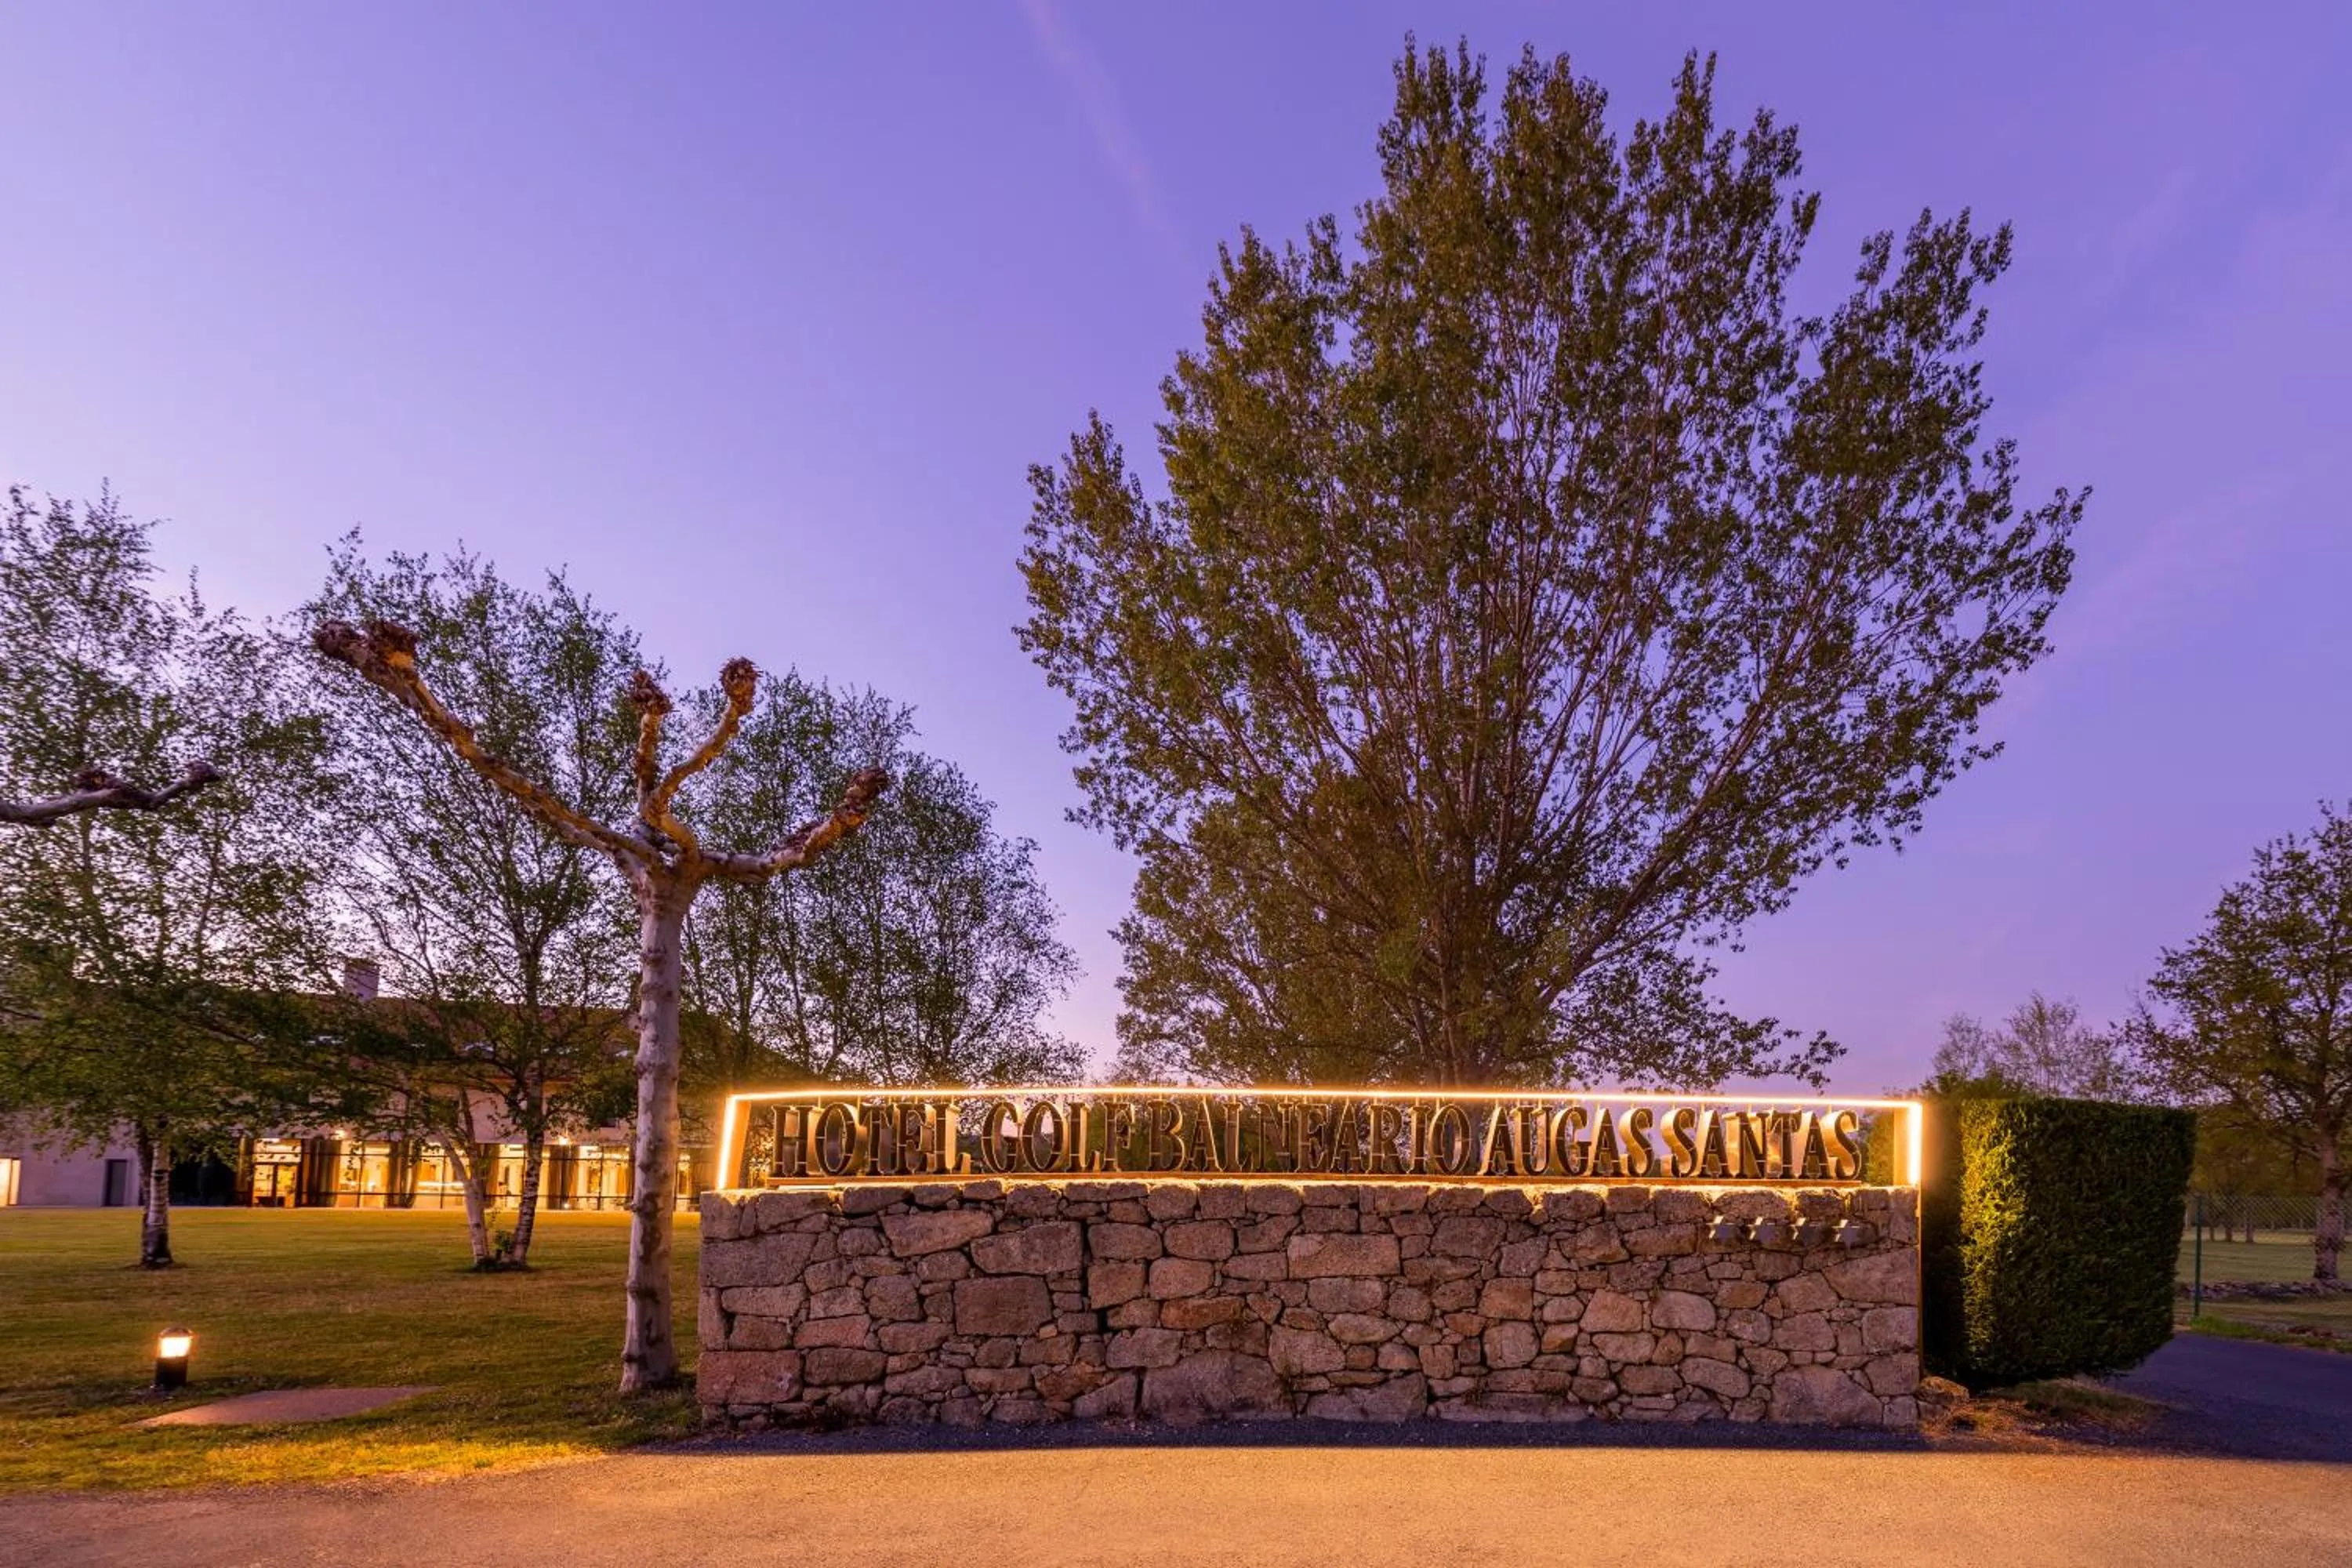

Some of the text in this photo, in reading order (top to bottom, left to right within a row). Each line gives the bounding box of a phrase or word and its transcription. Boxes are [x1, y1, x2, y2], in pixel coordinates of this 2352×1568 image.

[771, 1100, 1862, 1180] HOTEL GOLF BALNEARIO AUGAS SANTAS
